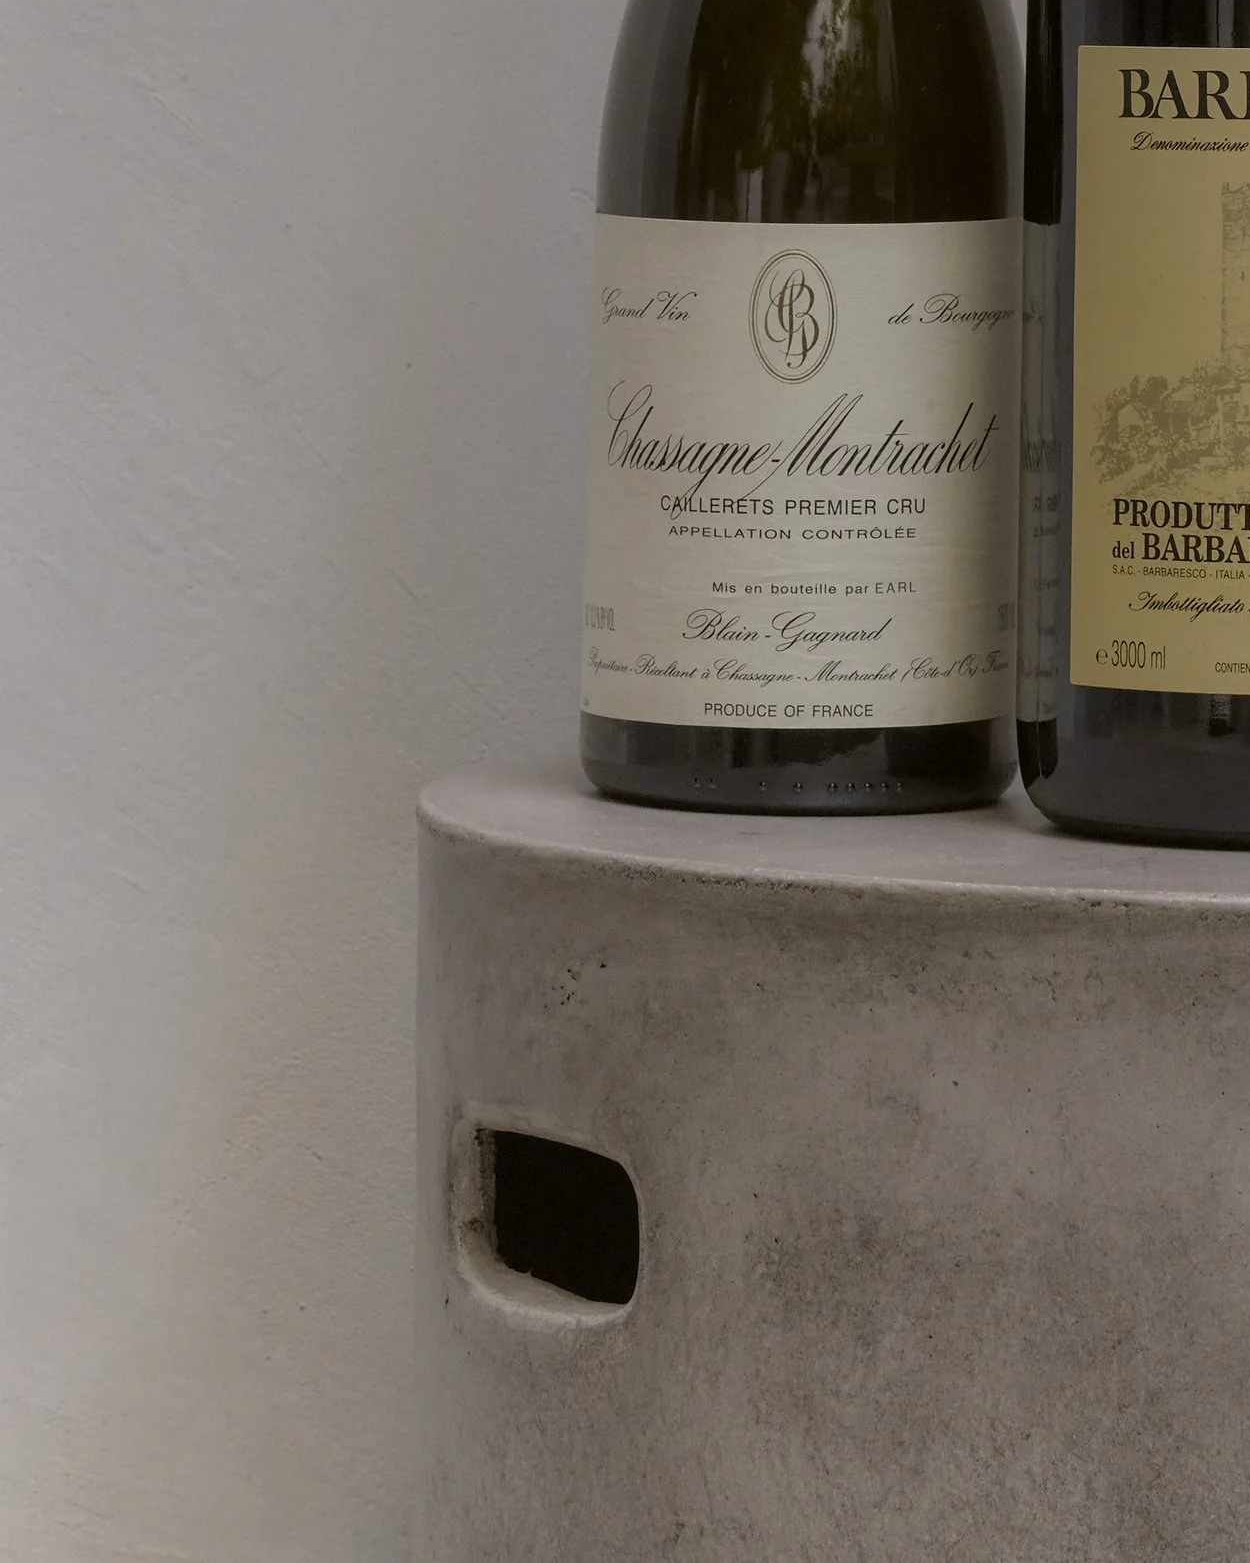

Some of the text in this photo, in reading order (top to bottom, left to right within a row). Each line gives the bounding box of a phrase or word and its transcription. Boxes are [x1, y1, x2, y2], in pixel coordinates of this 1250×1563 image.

[1130, 131, 1249, 152] Denominazione
[601, 286, 697, 325] Grand Vin
[887, 302, 915, 325] de
[661, 495, 925, 515] CAILLERETS PREMIER CRU
[669, 525, 916, 540] APPELLATION CONTRÔLÉE
[1112, 541, 1135, 559] del
[1143, 567, 1207, 579] BARBARESCO
[1215, 569, 1246, 580] ITALIA
[712, 582, 916, 597] Mis en bouteille par EARL
[1128, 591, 1245, 622] Imbottigliato
[1111, 640, 1146, 669] 3000
[1150, 646, 1166, 670] ml
[701, 668, 711, 679] à
[704, 703, 873, 718] PRODUCE OF FRANCE
